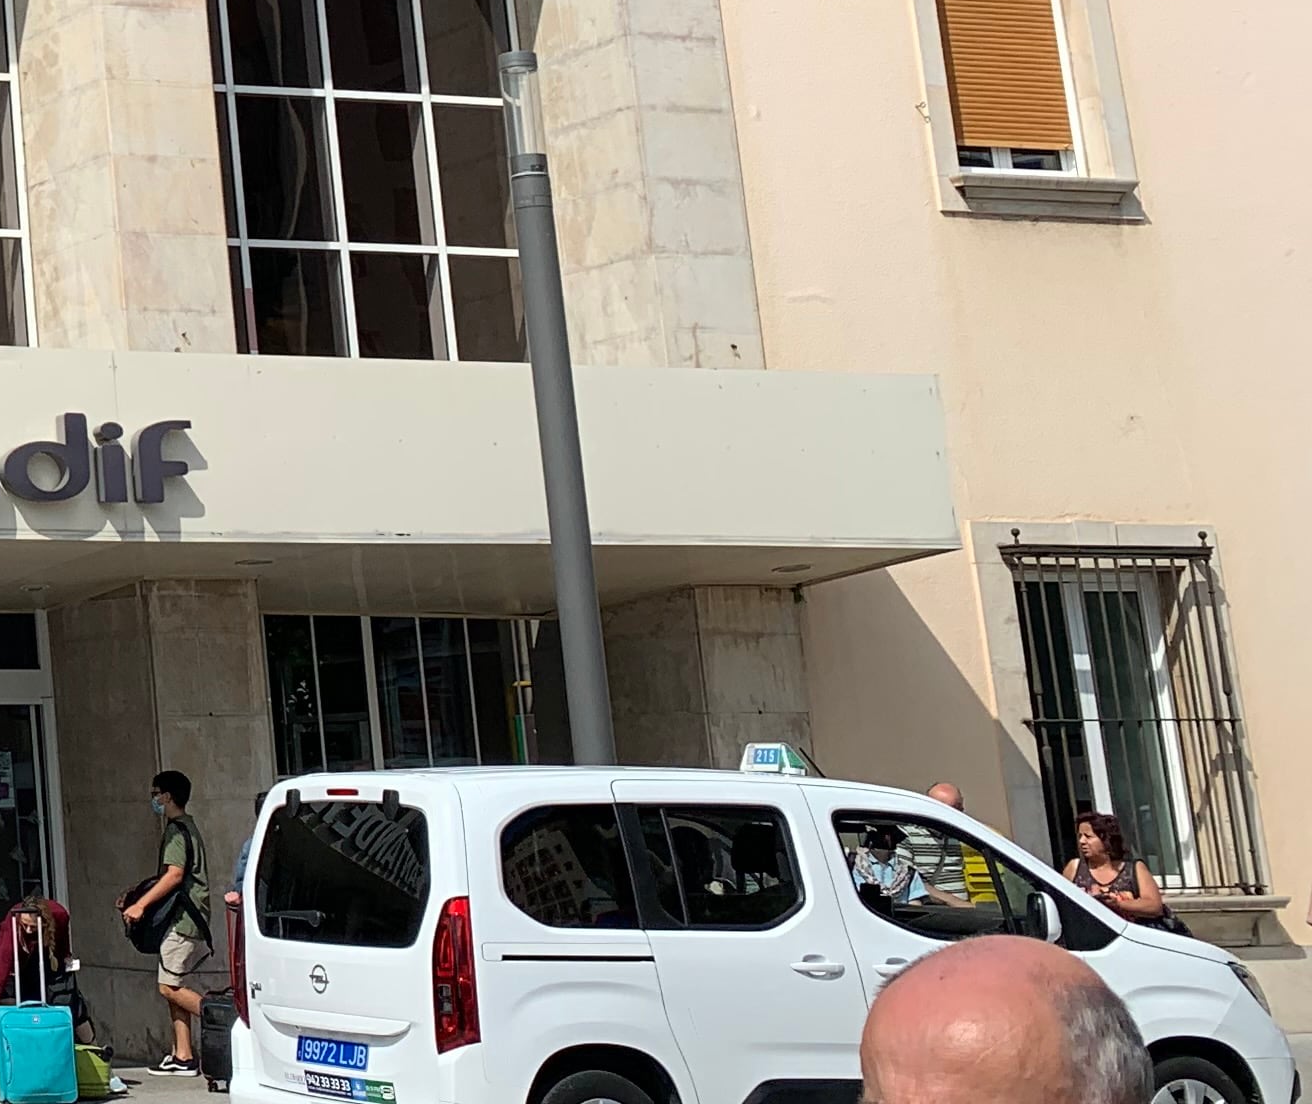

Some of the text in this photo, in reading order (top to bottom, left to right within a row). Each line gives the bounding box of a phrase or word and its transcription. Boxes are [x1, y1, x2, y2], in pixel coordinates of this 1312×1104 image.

[756, 750, 775, 763] 215
[304, 1039, 367, 1067] 9972 LJB
